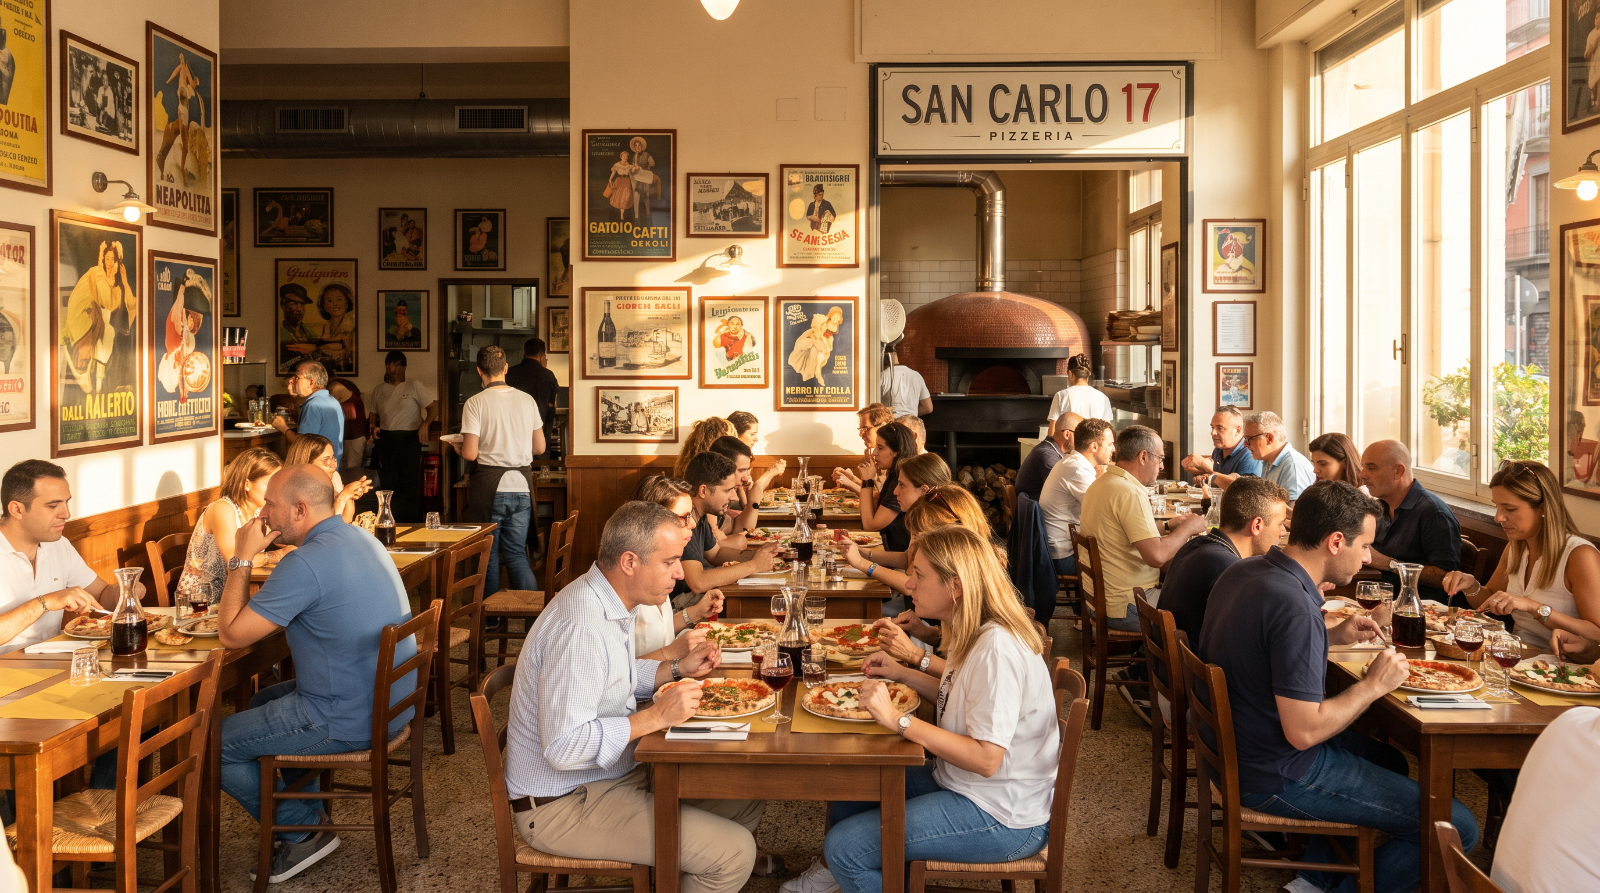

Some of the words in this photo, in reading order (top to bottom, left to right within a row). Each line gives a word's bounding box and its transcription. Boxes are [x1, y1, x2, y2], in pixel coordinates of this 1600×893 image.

[901, 84, 973, 125] SAN
[988, 83, 1109, 124] CARLO
[1121, 82, 1161, 123] 17
[989, 131, 1074, 141] PIZZERIA
[632, 226, 668, 239] CAFTI
[825, 386, 852, 395] COLLA
